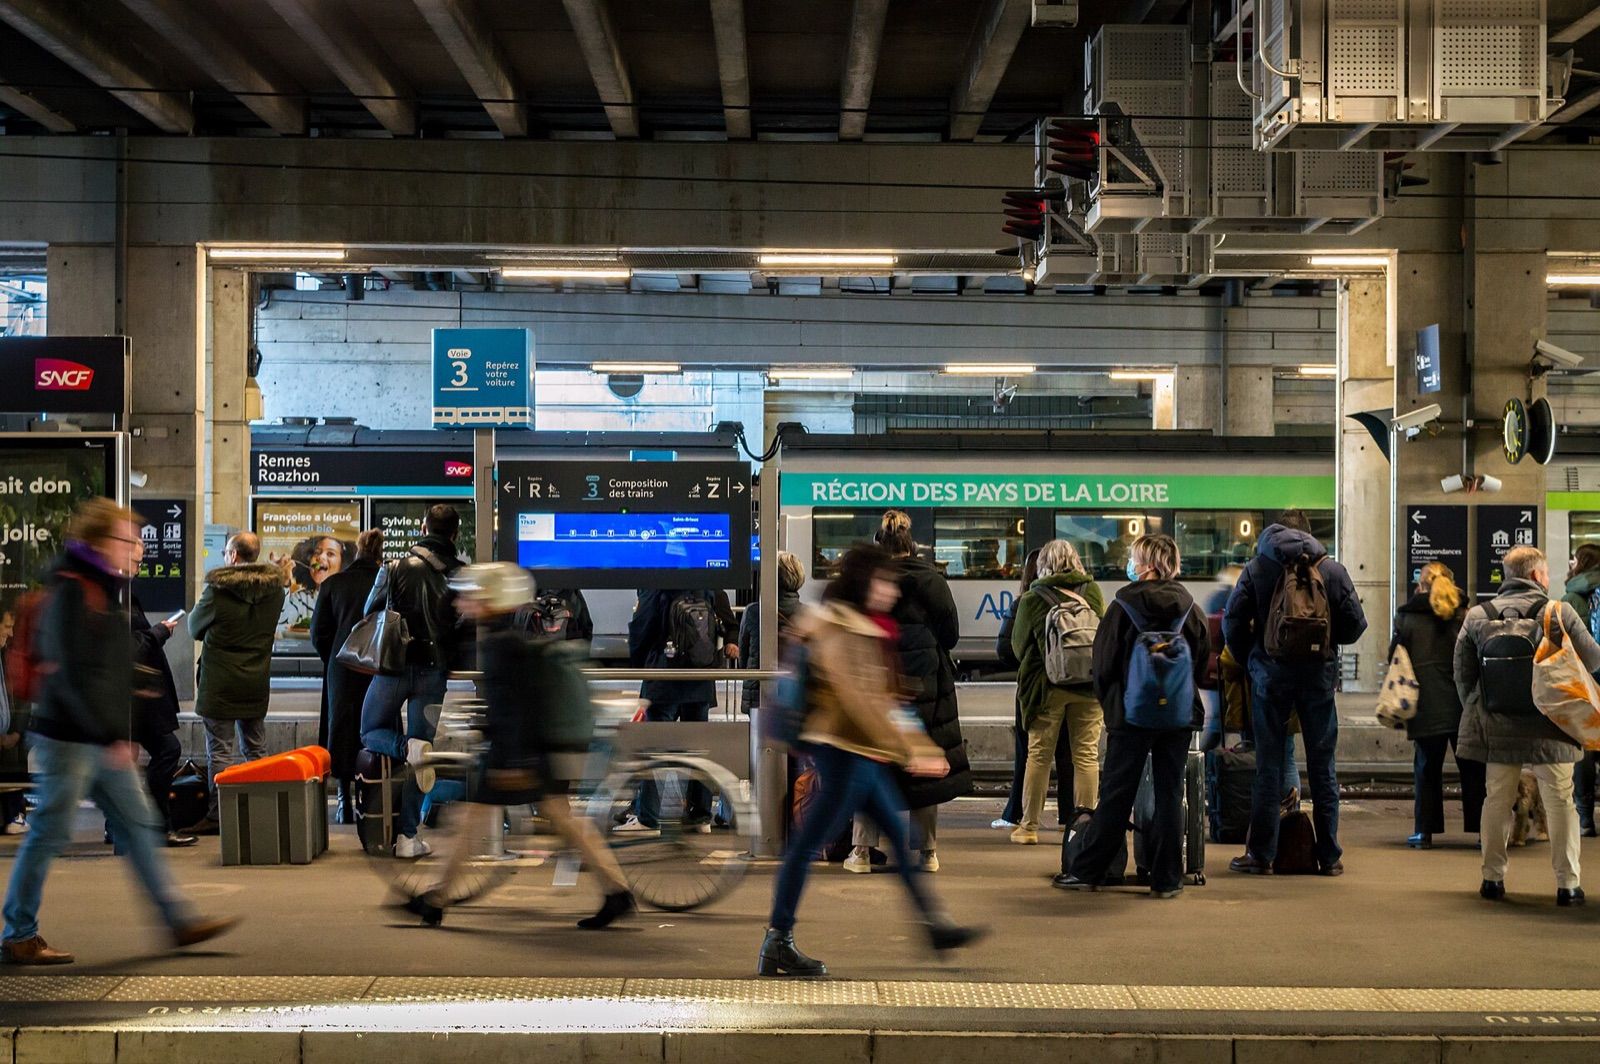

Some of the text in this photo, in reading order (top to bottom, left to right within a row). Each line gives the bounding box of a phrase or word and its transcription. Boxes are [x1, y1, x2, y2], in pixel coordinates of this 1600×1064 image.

[451, 350, 468, 358] Voie
[485, 361, 519, 371] Repérez
[38, 369, 91, 387] SNCF
[451, 360, 468, 387] 3
[485, 379, 516, 387] voiture
[258, 454, 311, 468] Rennes
[258, 468, 320, 482] Roazhon
[446, 465, 472, 476] SNCF
[30, 476, 71, 494] don
[609, 478, 668, 489] Composition
[529, 483, 541, 498] R
[587, 482, 598, 497] 3
[609, 489, 654, 498] des trains
[707, 483, 720, 498] Z
[812, 477, 1169, 502] RÉGION DES PAYS DE LA LOIRE
[263, 512, 352, 524] Françoise a légué
[382, 516, 412, 527] Sylvie
[1, 523, 48, 545] jolie
[279, 524, 314, 533] brocoli
[316, 524, 335, 533] bio.
[382, 540, 406, 549] pour
[382, 550, 411, 558] renco
[1411, 548, 1462, 556] Correspondances
